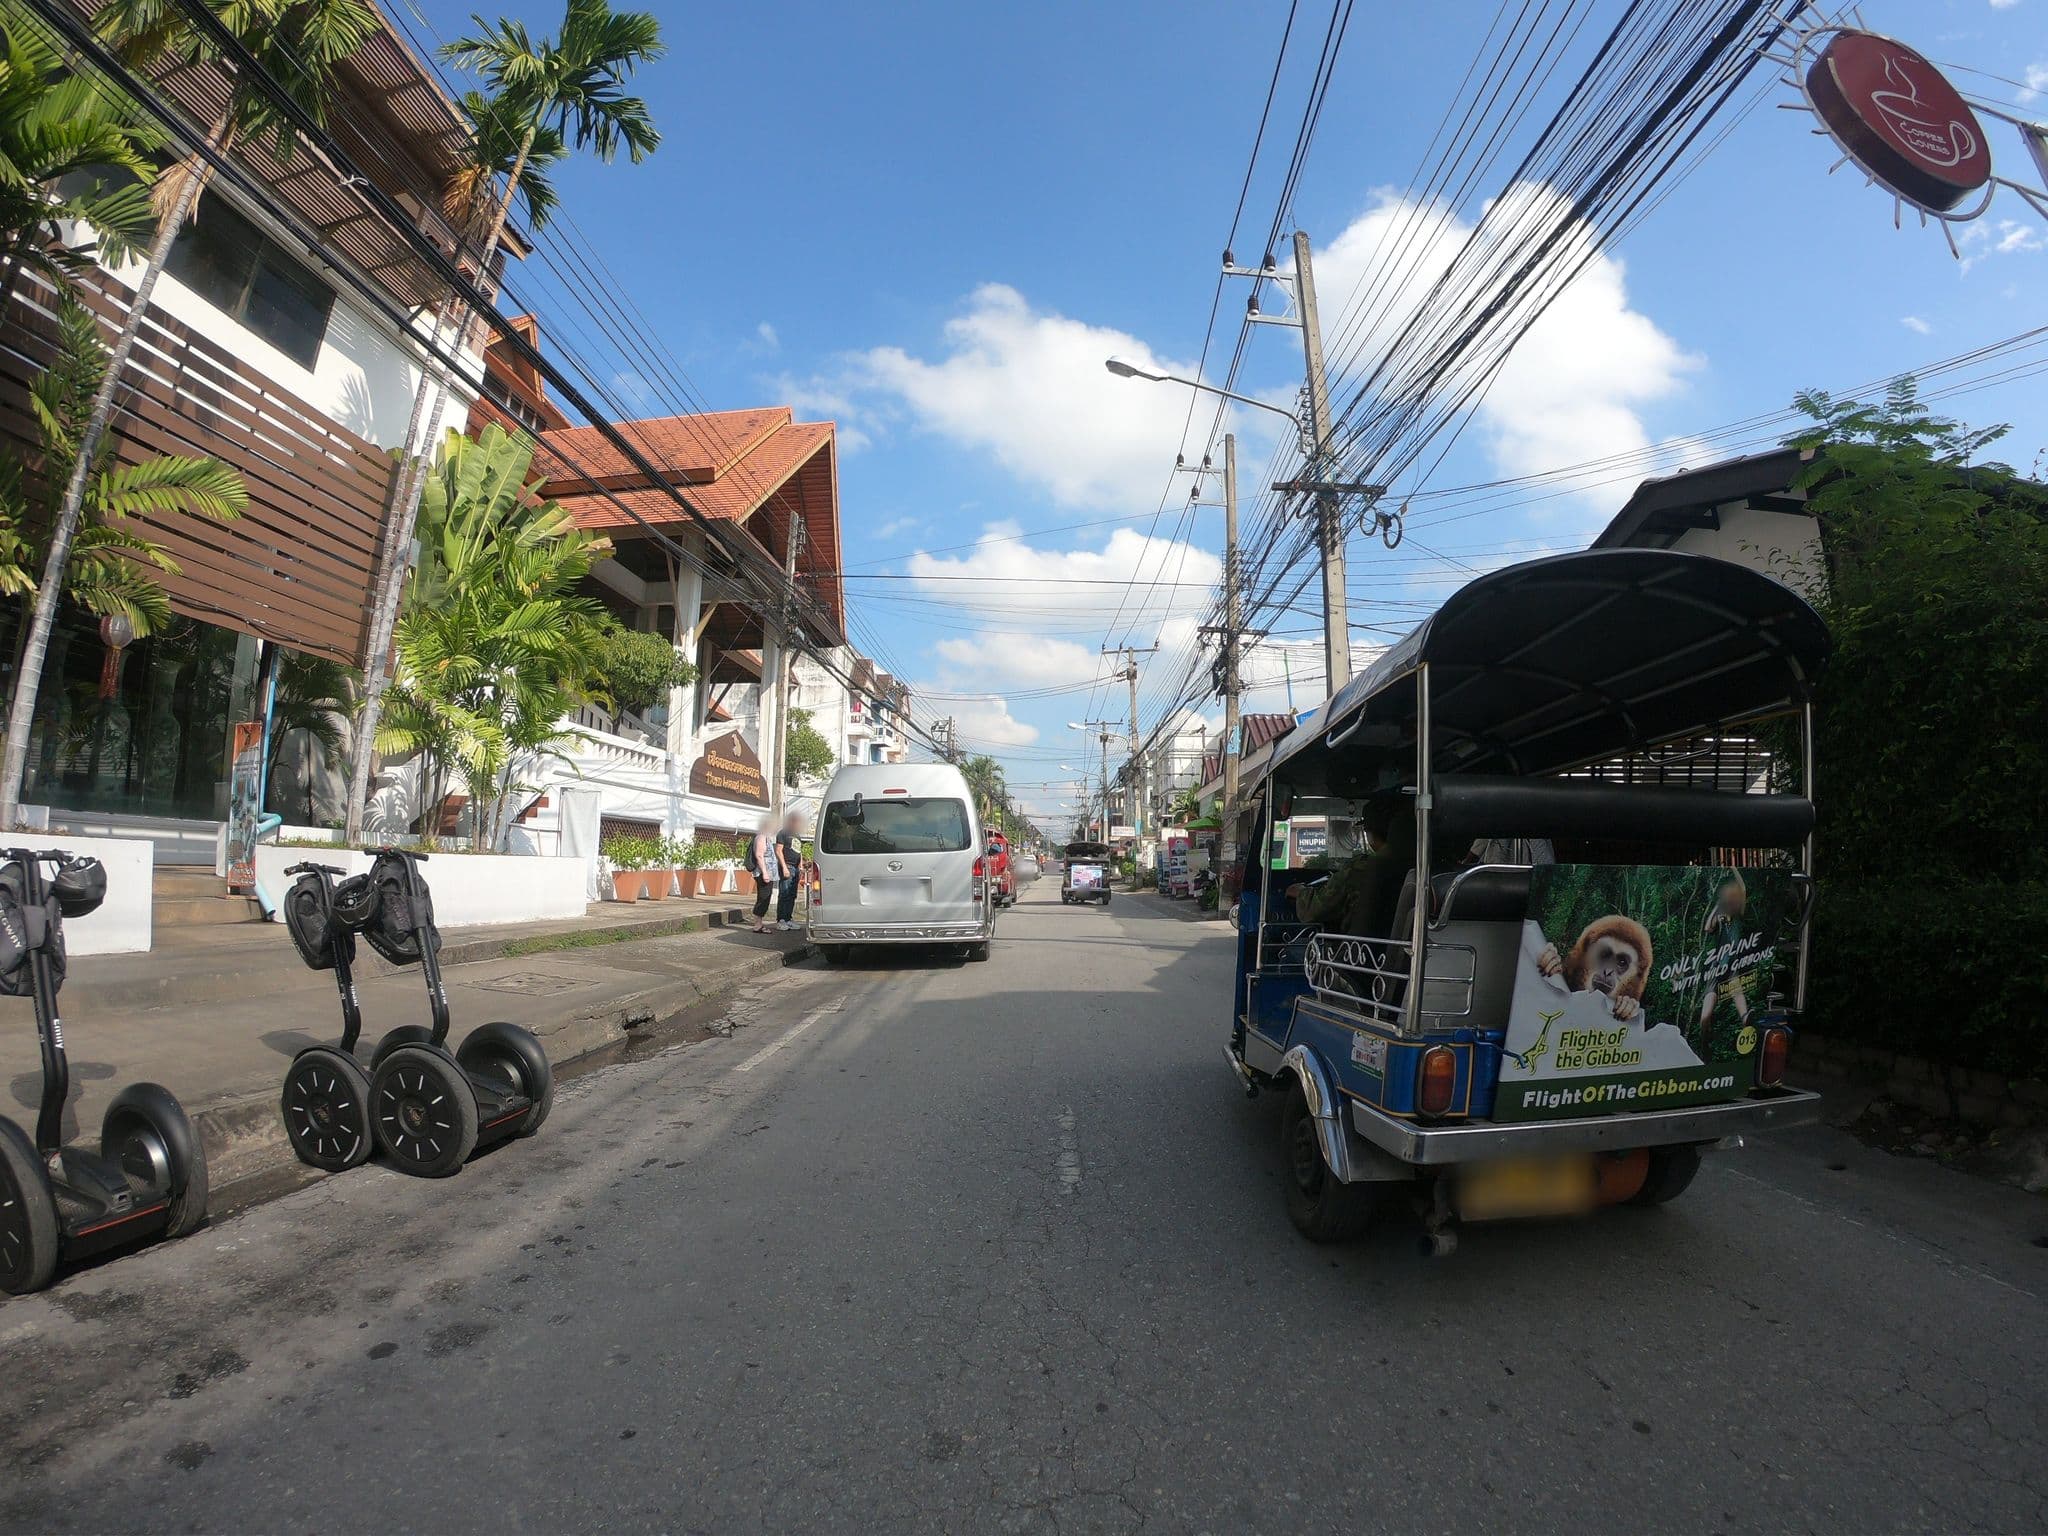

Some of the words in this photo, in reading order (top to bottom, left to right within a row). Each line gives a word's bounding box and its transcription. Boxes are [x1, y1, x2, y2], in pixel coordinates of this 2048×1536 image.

[1660, 949, 1703, 980] ONLY
[1703, 932, 1763, 966] ZIPLINE
[1672, 972, 1702, 993] WITH
[1703, 963, 1729, 981] WILD
[1731, 946, 1775, 972] GIBBONS
[1560, 1030, 1603, 1051] Flight
[1608, 1028, 1626, 1045] of
[1556, 1053, 1585, 1068] the
[1586, 1049, 1640, 1067] Gibbon
[1522, 1074, 1734, 1109] FlightOfTheGibbon.com
